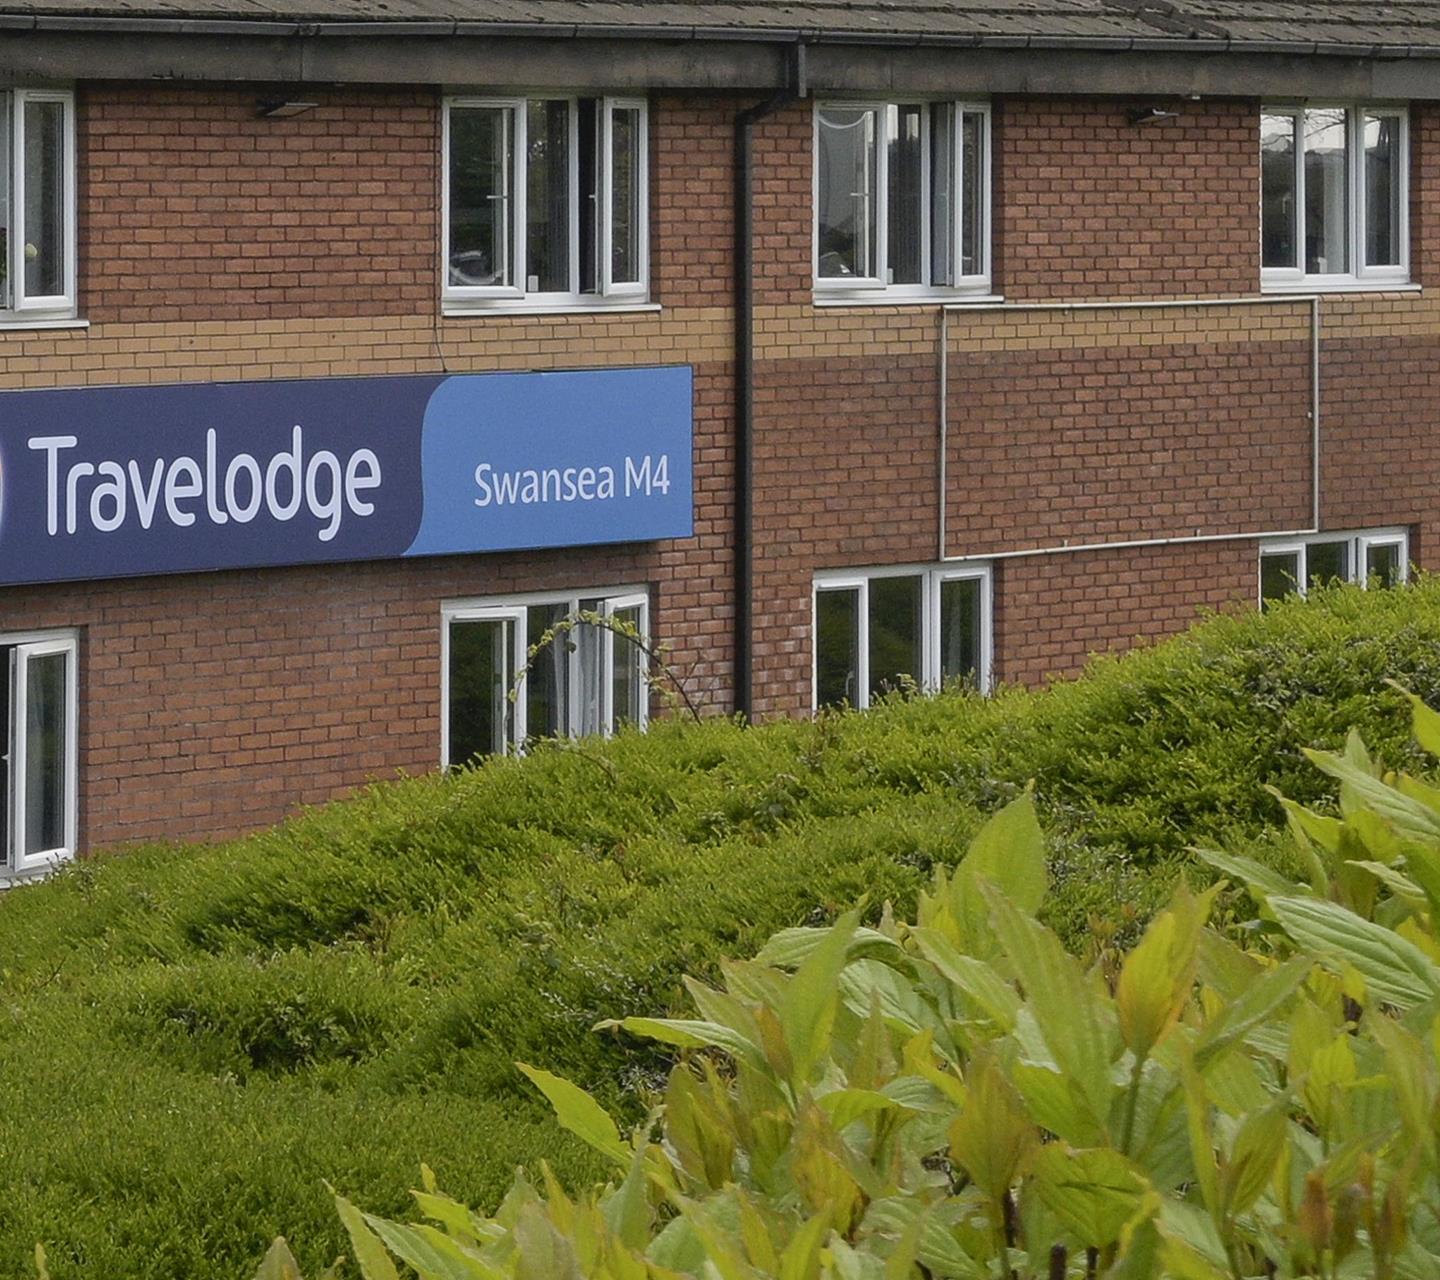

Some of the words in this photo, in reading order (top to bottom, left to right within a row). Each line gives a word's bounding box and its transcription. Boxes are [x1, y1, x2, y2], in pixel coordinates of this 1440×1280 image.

[27, 425, 382, 542] Travelodge
[474, 464, 614, 507] Swansea
[625, 455, 670, 497] M4
